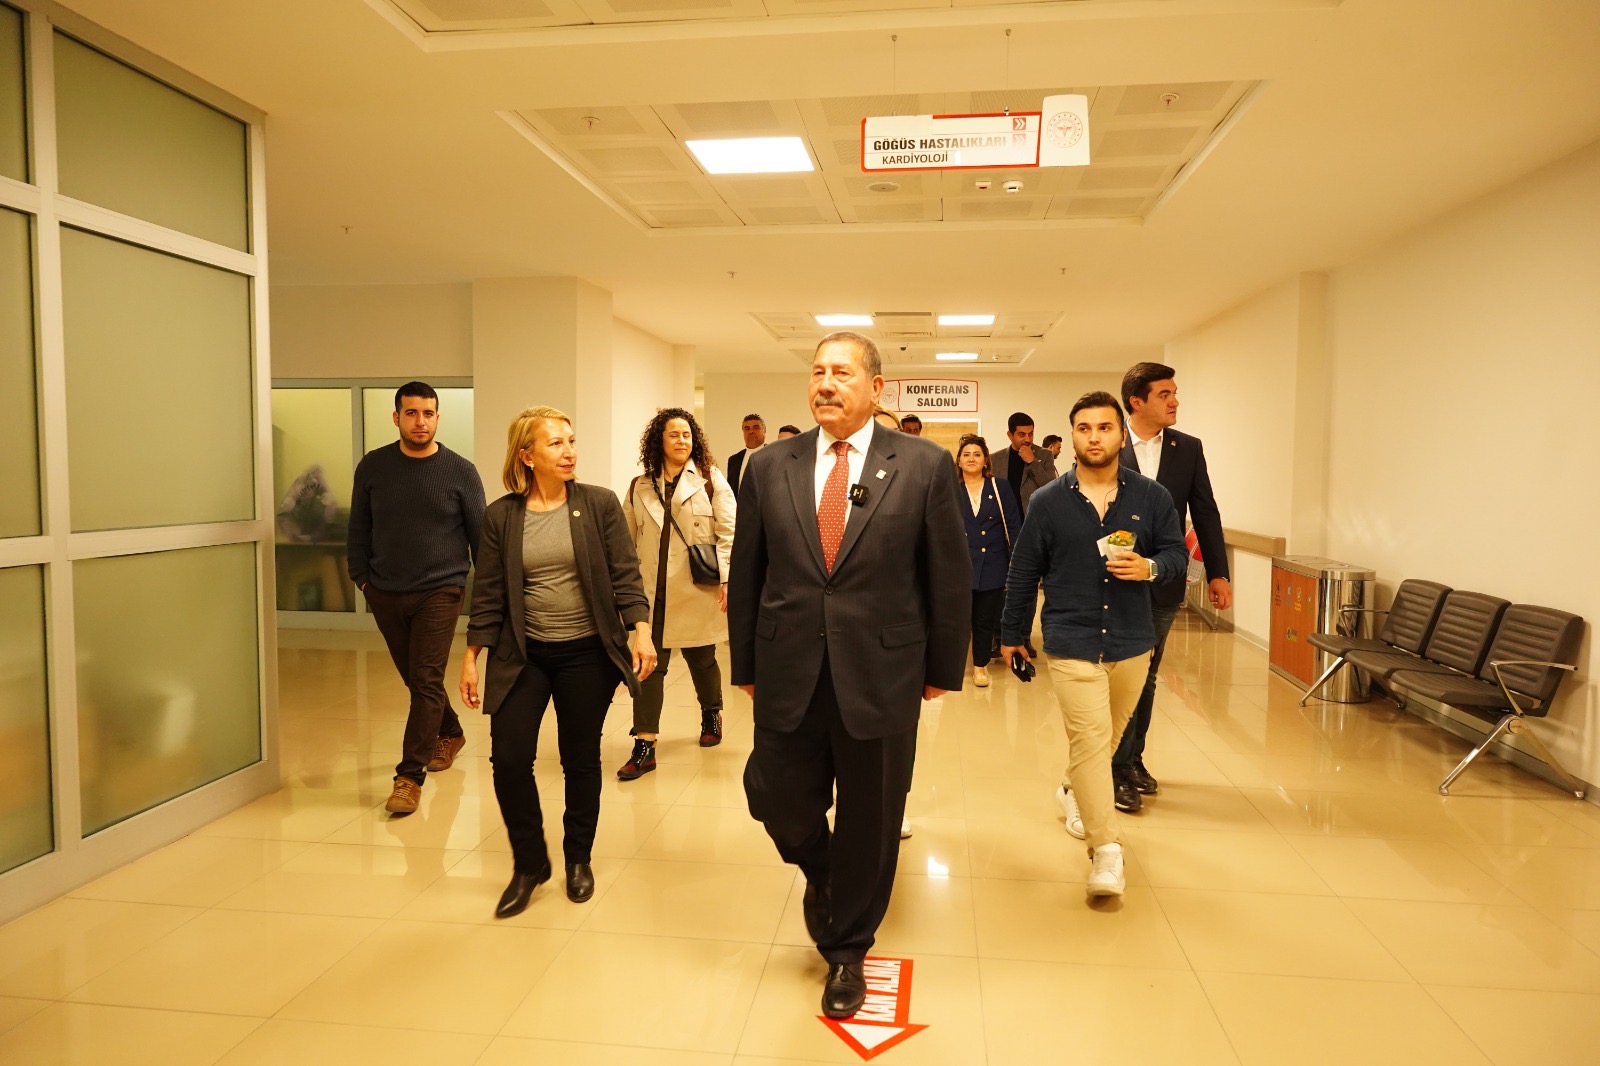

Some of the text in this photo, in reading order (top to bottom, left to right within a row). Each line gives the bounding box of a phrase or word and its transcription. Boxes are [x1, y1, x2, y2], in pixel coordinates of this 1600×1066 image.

[873, 136, 1006, 151] GÖĞÜS HASTALIKLARI
[882, 151, 948, 165] KARDİYOLOJİ
[906, 385, 969, 394] KONFERANS
[917, 397, 958, 407] SALONU
[853, 994, 898, 1023] KAN
